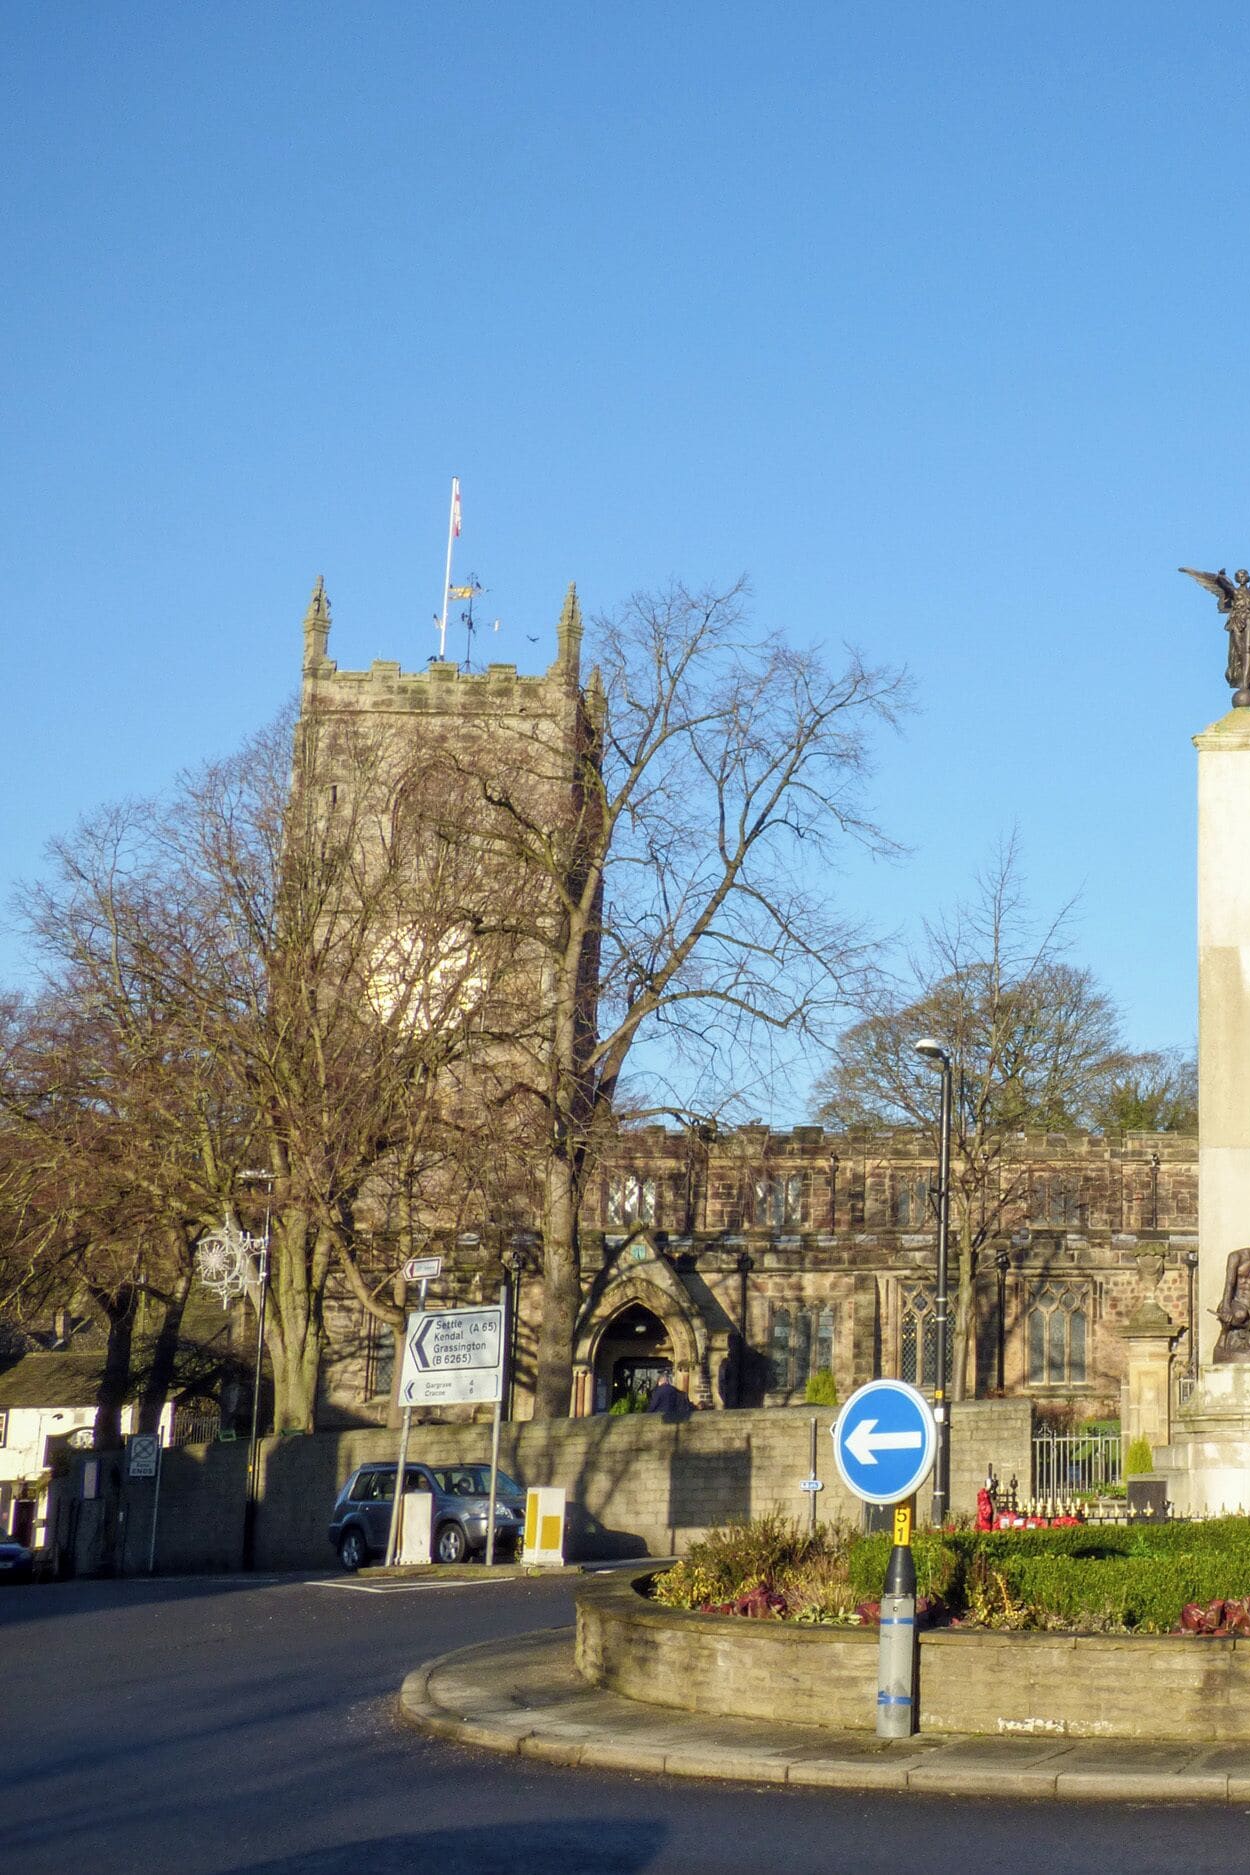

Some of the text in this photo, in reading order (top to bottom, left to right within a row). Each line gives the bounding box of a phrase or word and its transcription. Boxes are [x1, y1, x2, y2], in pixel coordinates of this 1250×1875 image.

[436, 1320, 463, 1330] Settle
[469, 1321, 497, 1334] (A 65)
[434, 1331, 464, 1341] Kendal
[433, 1342, 487, 1354] Grassington
[432, 1353, 472, 1366] (B 6265)
